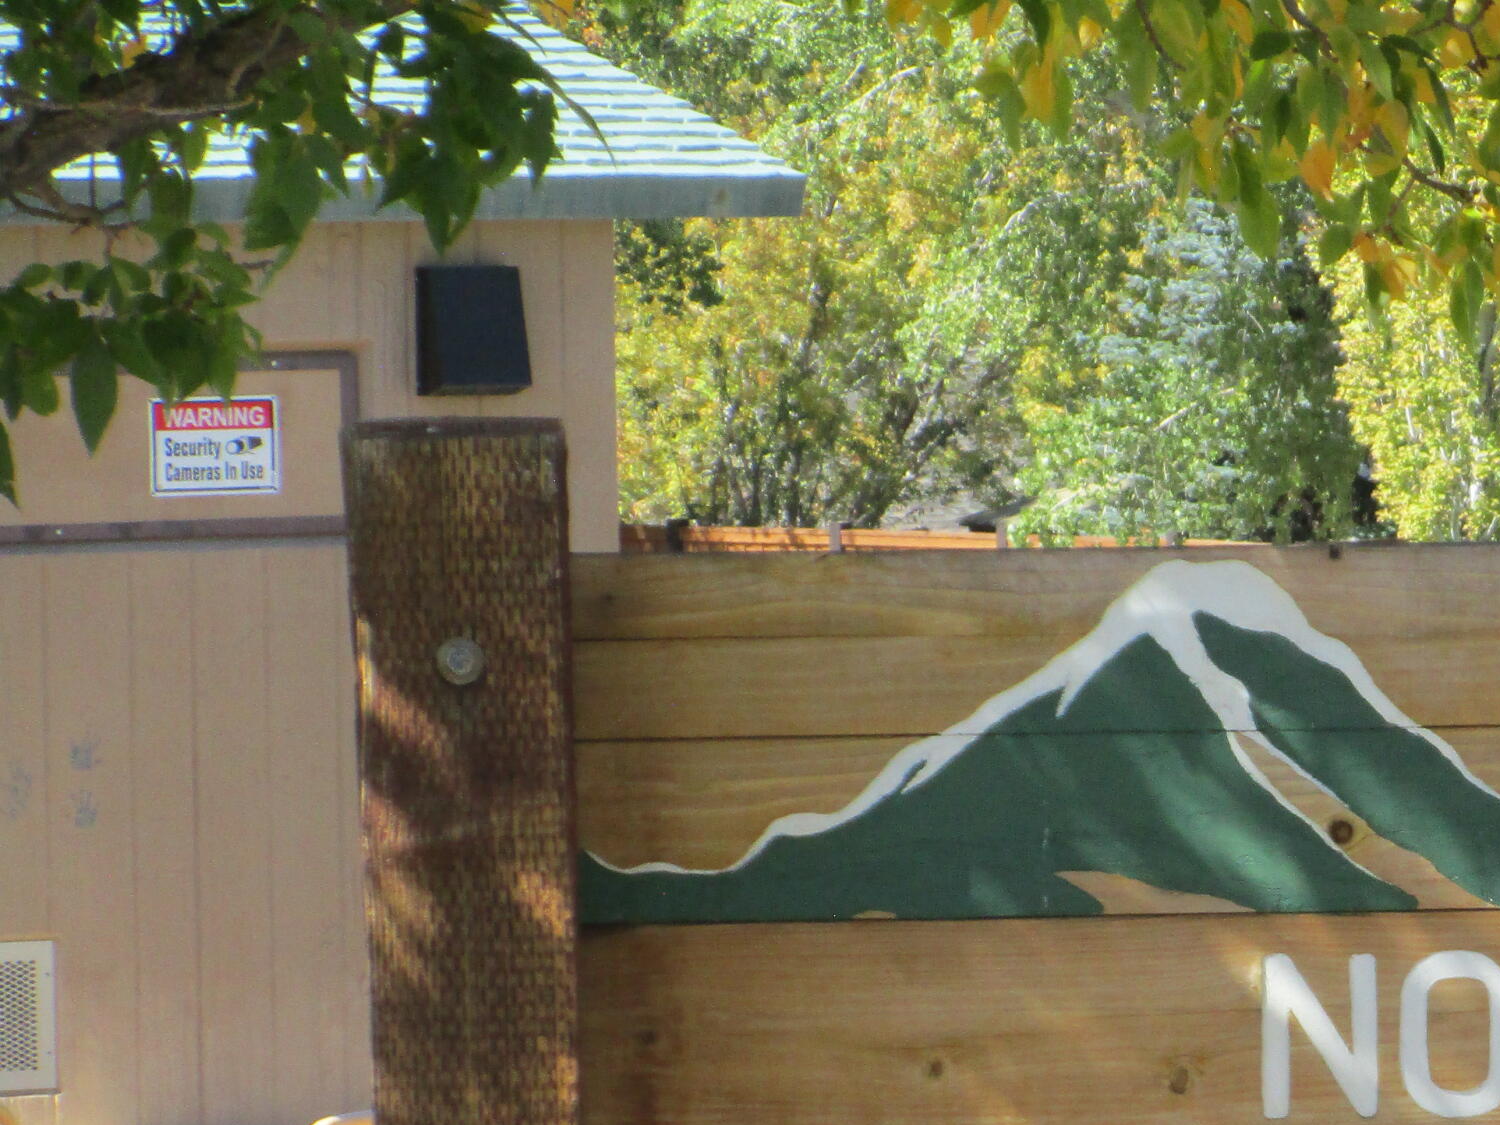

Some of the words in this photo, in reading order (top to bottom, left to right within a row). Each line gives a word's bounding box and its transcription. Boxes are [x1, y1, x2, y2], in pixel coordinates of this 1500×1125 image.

[164, 406, 265, 427] WARNING
[164, 437, 220, 459] Security
[165, 462, 221, 481] Cameras
[225, 461, 237, 480] In
[241, 460, 264, 479] Use
